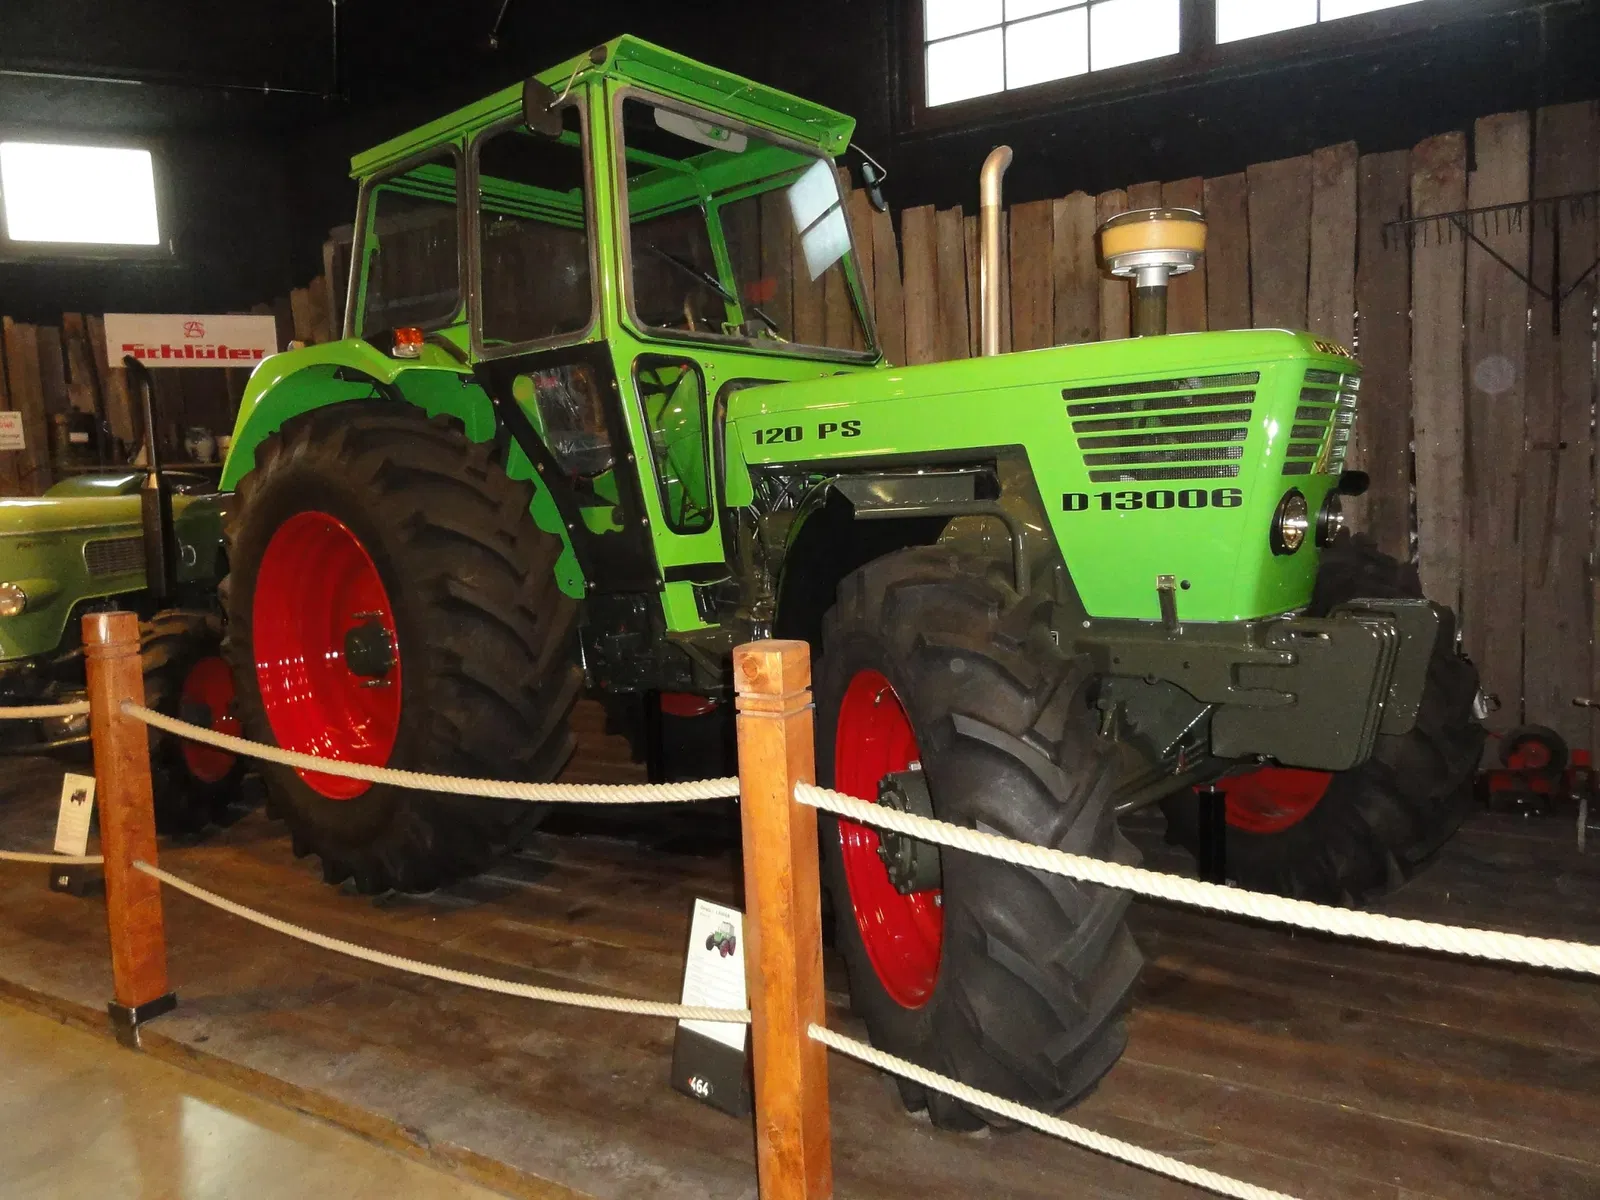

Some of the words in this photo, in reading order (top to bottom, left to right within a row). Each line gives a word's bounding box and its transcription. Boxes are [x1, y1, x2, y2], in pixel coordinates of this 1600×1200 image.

[122, 344, 265, 360] Schlüter
[752, 426, 803, 445] 120
[818, 420, 861, 439] PS
[690, 1076, 709, 1096] 464
